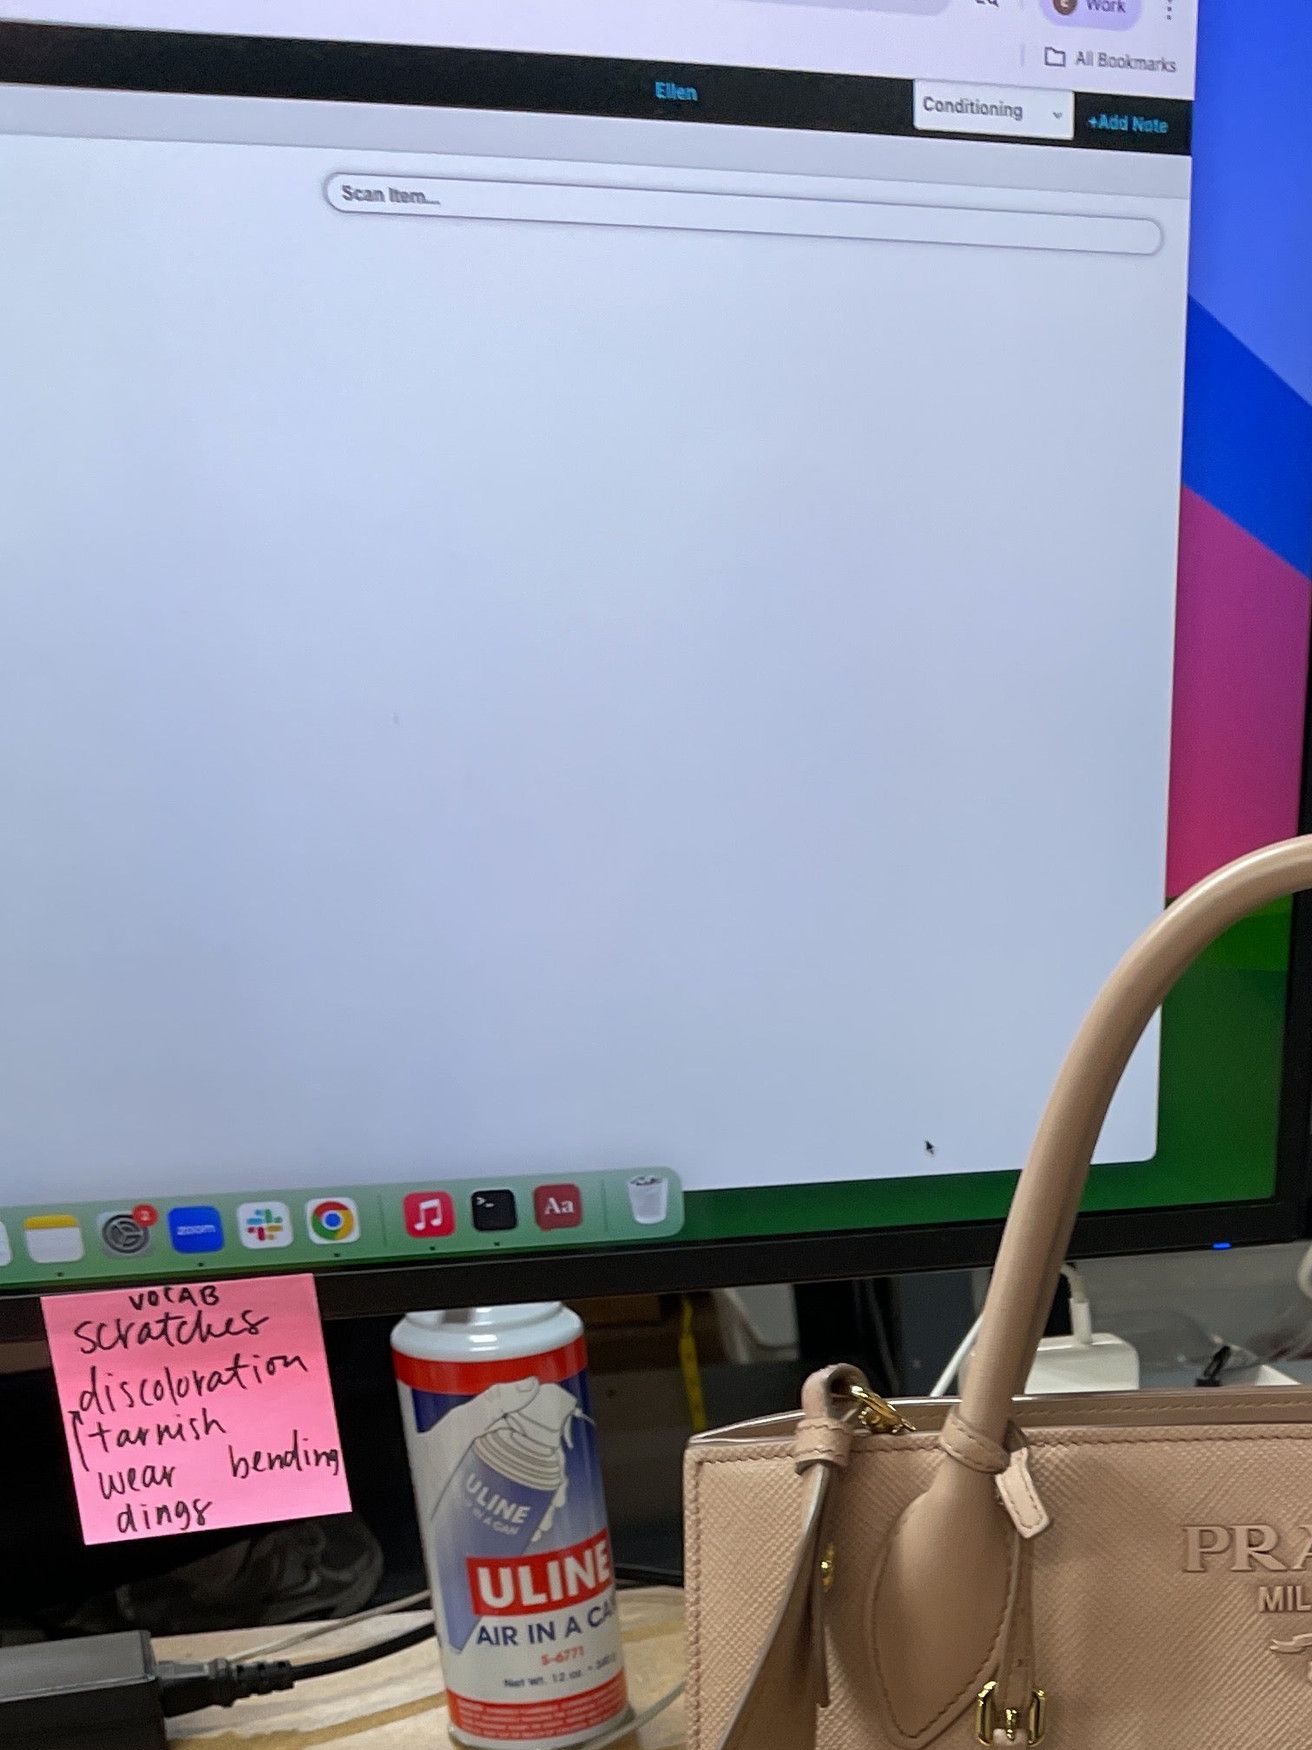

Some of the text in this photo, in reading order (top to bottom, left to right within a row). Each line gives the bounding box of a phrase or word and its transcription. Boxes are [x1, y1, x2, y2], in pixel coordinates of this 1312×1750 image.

[1086, 0, 1126, 14] Work
[1075, 50, 1177, 73] All Bookmarks
[655, 81, 698, 101] Ellen
[922, 96, 1023, 121] Conditioning
[1132, 116, 1169, 134] Note
[341, 185, 385, 202] Scan
[543, 1196, 575, 1216] Aa
[79, 1353, 309, 1415] discoloration
[88, 1407, 227, 1453] tarnish
[228, 1429, 341, 1480] bending
[466, 1473, 531, 1524] ULINE
[116, 1498, 213, 1534] dings
[477, 1539, 610, 1609] ULINE
[477, 1624, 518, 1647] AIR
[527, 1621, 557, 1645] IN
[564, 1614, 583, 1638] A
[541, 1645, 585, 1666] S-6771
